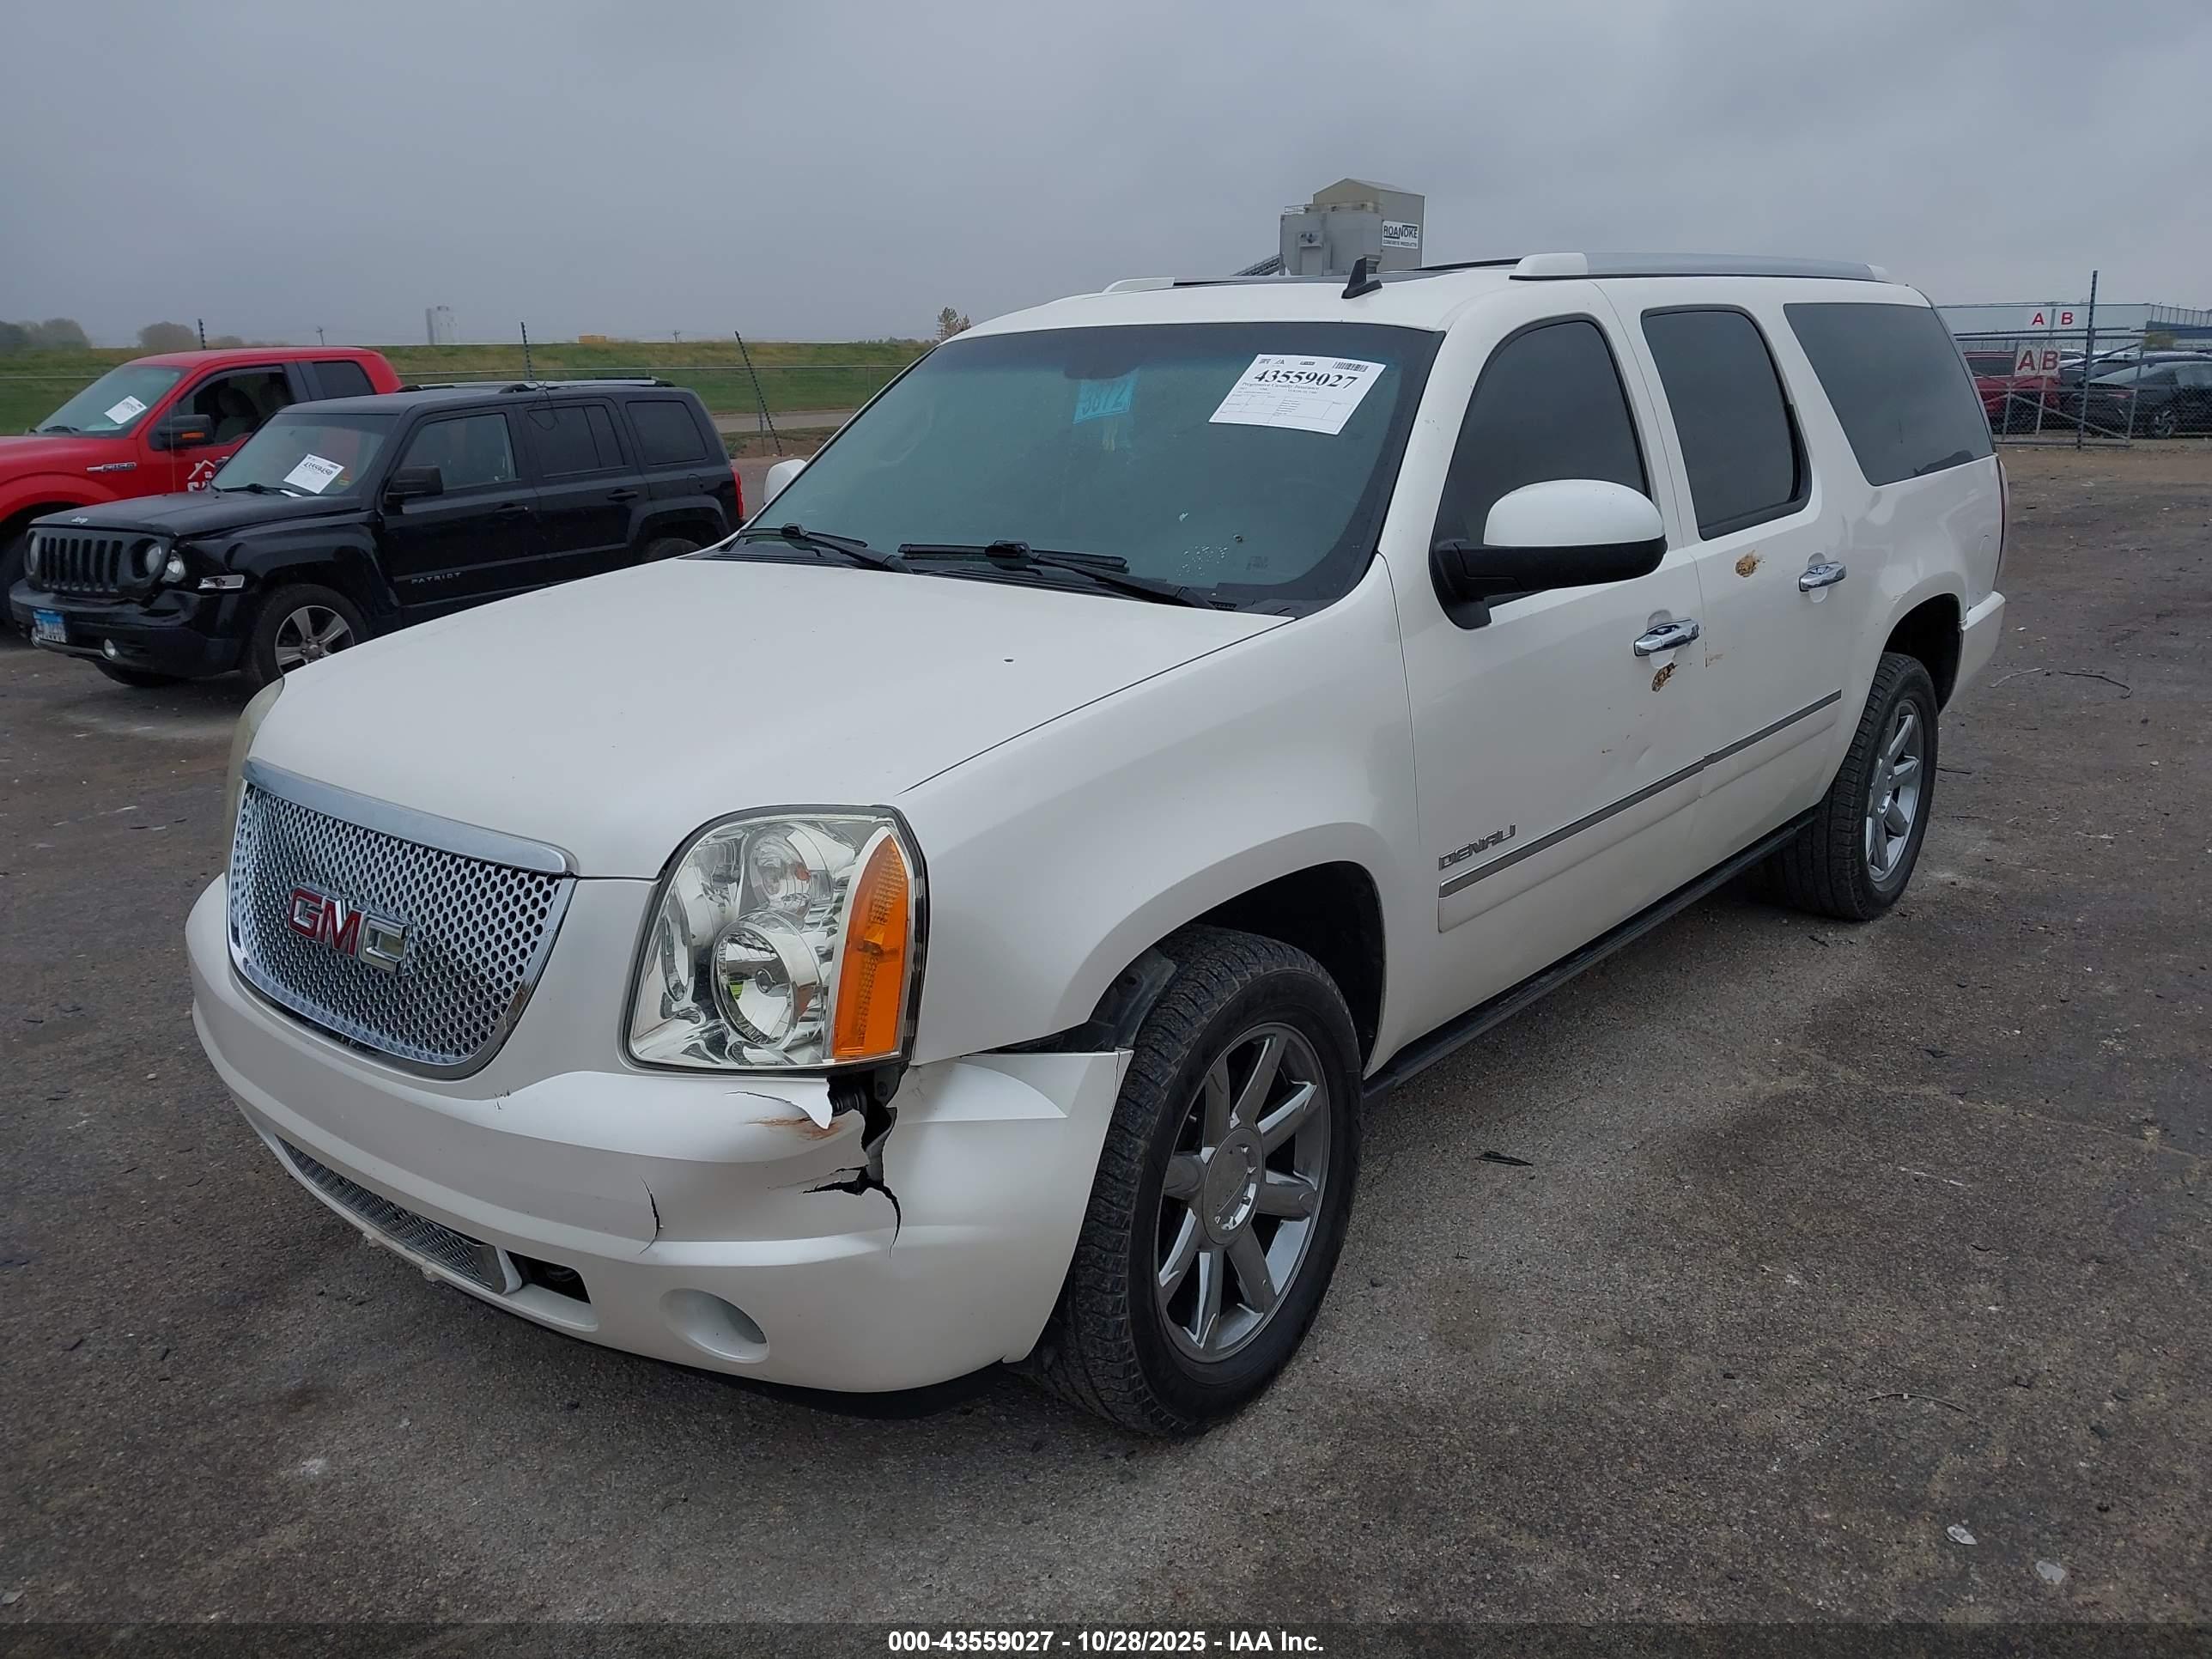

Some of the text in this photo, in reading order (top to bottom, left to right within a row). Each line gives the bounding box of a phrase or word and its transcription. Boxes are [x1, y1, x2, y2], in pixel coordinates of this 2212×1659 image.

[1383, 225, 1418, 239] ROANOKE
[2032, 312, 2074, 325] A B
[2018, 350, 2058, 370] A B
[1254, 369, 1358, 390] 43559027
[411, 572, 461, 585] PATRIOT
[1438, 823, 1516, 871] DENALI
[288, 884, 409, 975] GMC
